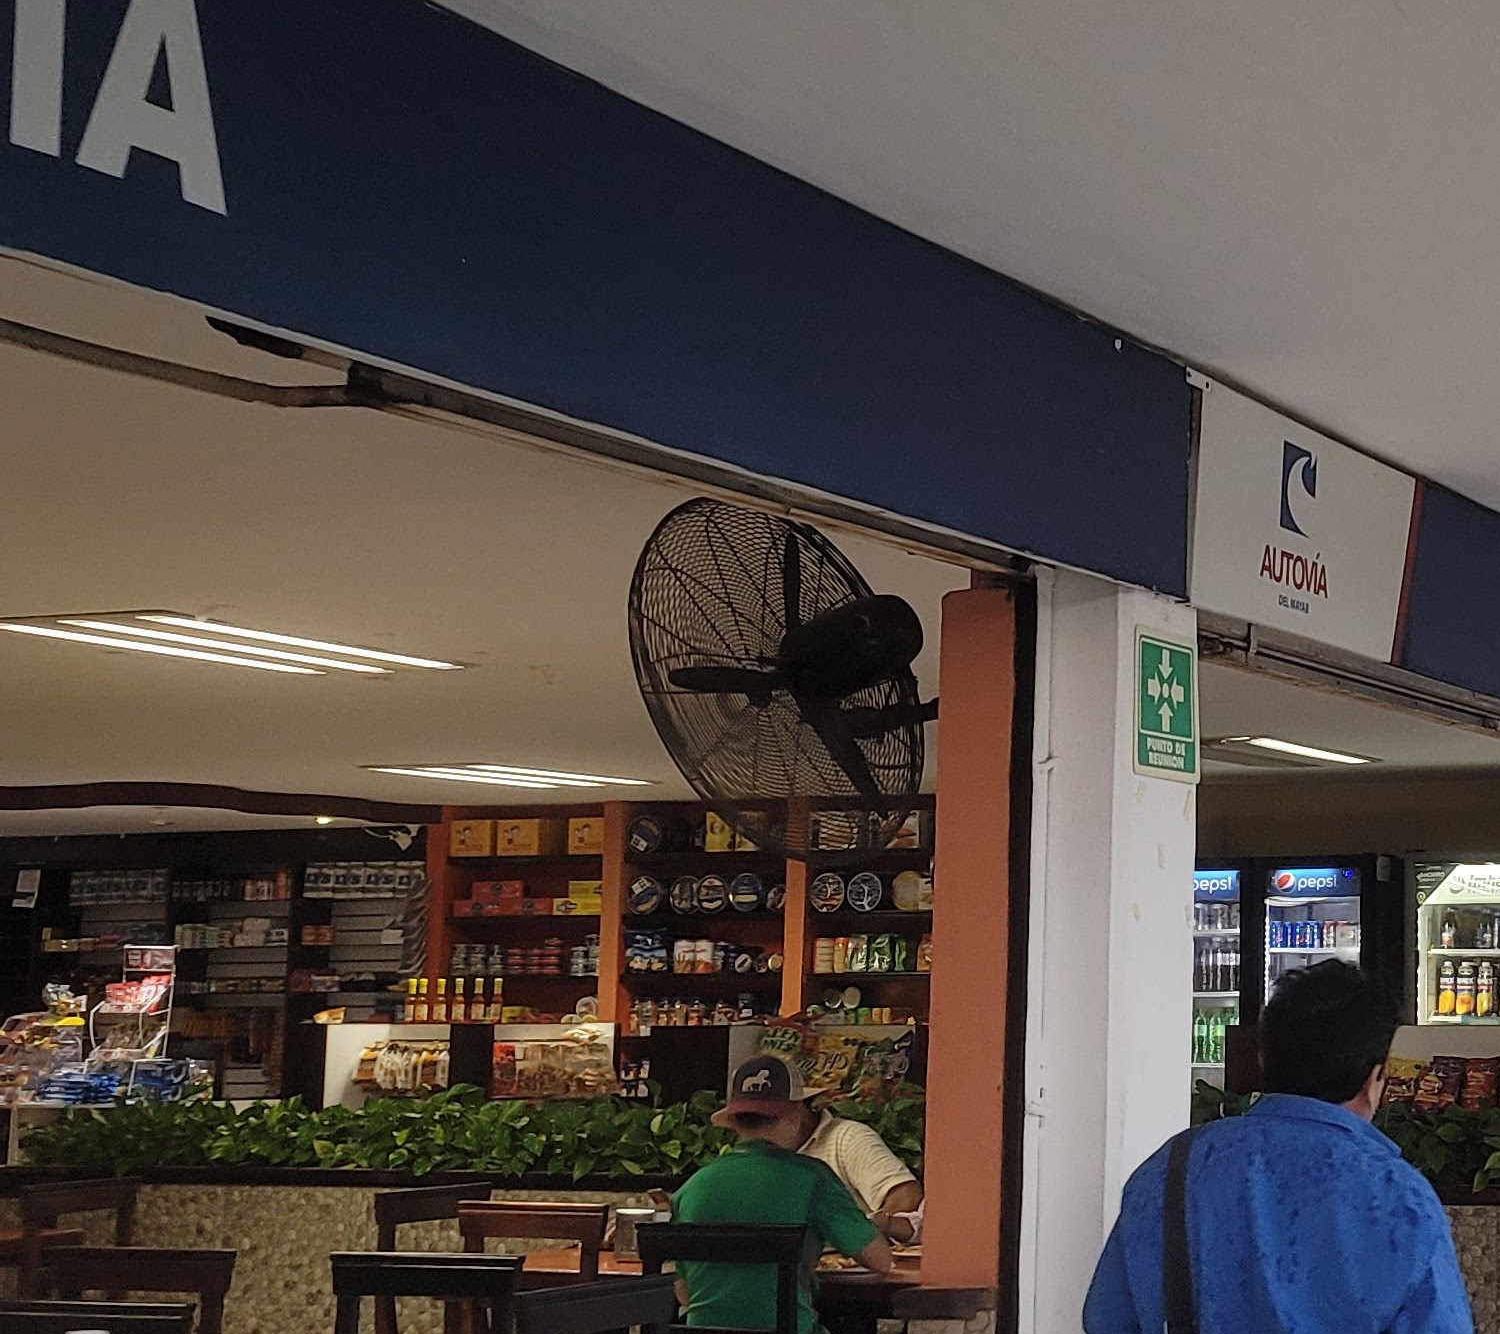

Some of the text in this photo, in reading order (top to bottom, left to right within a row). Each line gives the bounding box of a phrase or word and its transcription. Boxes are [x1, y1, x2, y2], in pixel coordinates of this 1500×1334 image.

[1260, 544, 1328, 599] AUTOVÍA
[1278, 595, 1289, 609] DEL
[1147, 738, 1186, 756] PUNTO DE
[1298, 874, 1337, 891] pepsi
